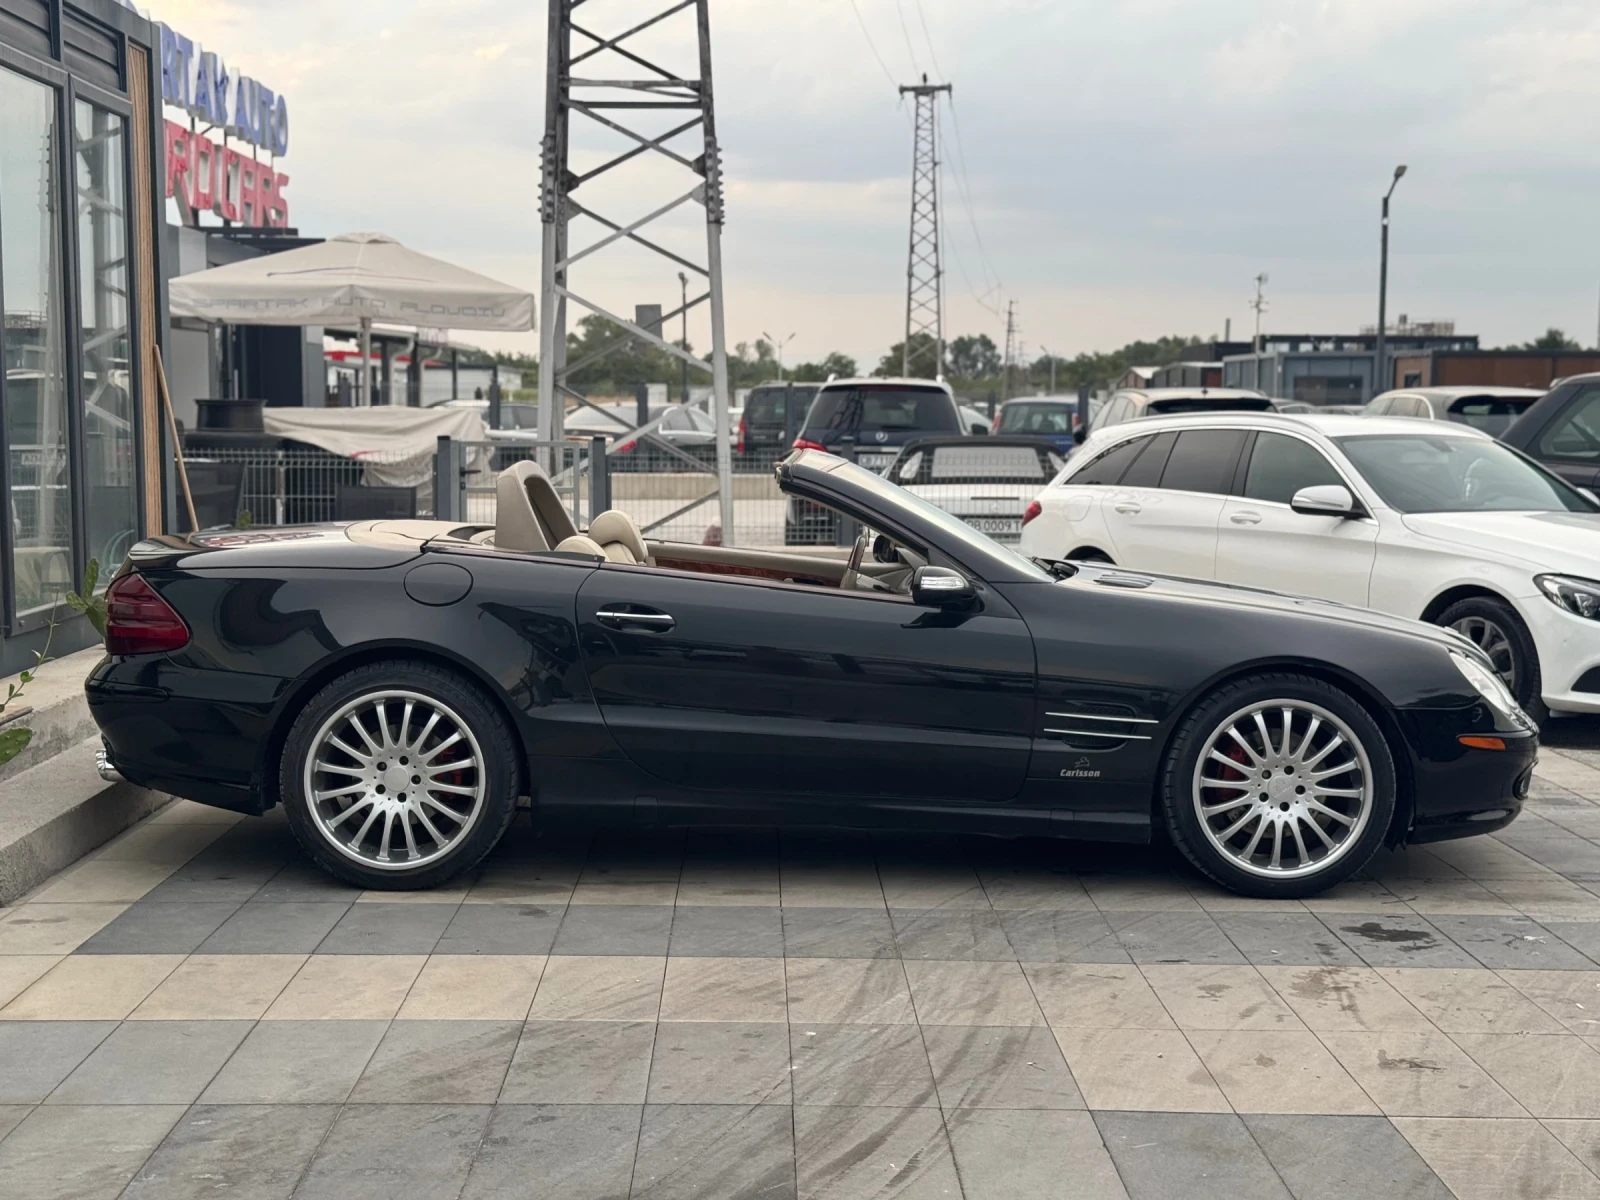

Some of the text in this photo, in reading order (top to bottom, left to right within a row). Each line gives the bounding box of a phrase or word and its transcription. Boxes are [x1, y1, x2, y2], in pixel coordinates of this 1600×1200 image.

[160, 20, 288, 157] RTAK AUTO
[983, 520, 1012, 531] 0009
[1060, 769, 1100, 777] Carlsson
